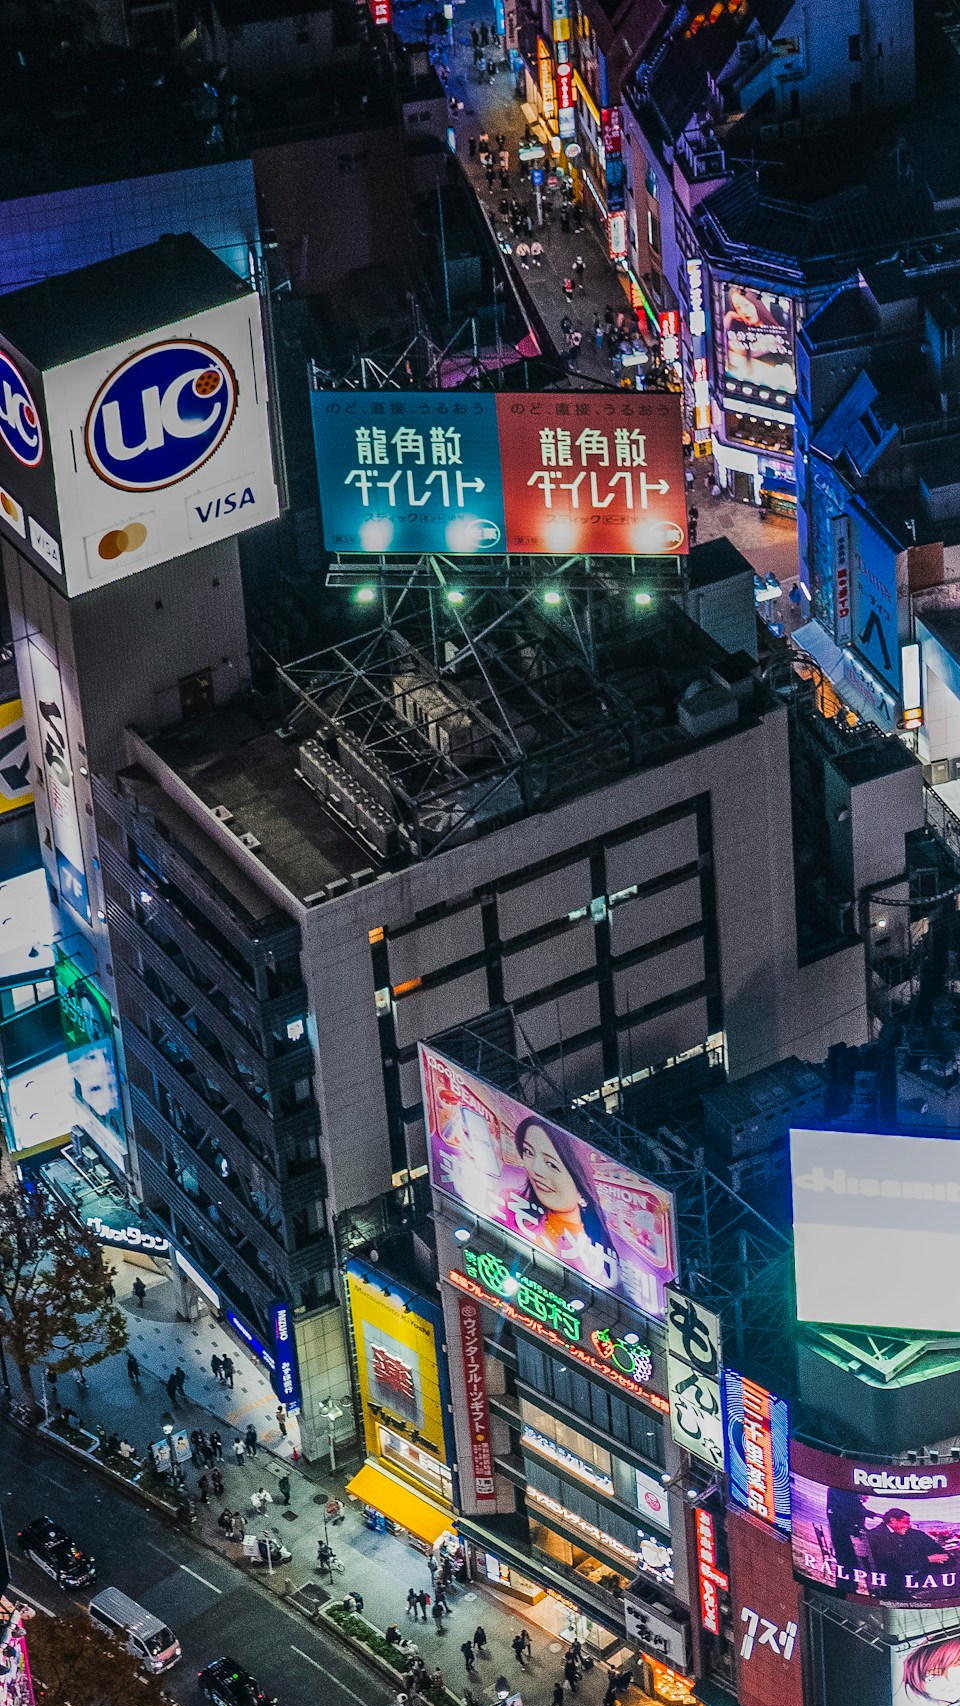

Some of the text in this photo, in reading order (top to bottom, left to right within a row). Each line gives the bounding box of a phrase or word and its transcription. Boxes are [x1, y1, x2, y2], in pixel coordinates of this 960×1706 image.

[355, 426, 463, 465] 龍角散
[539, 427, 647, 467] 龍角散
[195, 487, 256, 523] VISA
[344, 470, 486, 507] ダイレクト
[527, 471, 670, 509] ダイレクト
[36, 534, 58, 561] VISA
[462, 1318, 486, 1433] ウィンターフルーツギフト
[669, 1297, 722, 1464] もんじゃ
[743, 1388, 769, 1518] 三千里薬品
[853, 1468, 948, 1492] Rakuten
[804, 1554, 888, 1588] RALPH
[879, 1599, 932, 1608] Rakuten Vision
